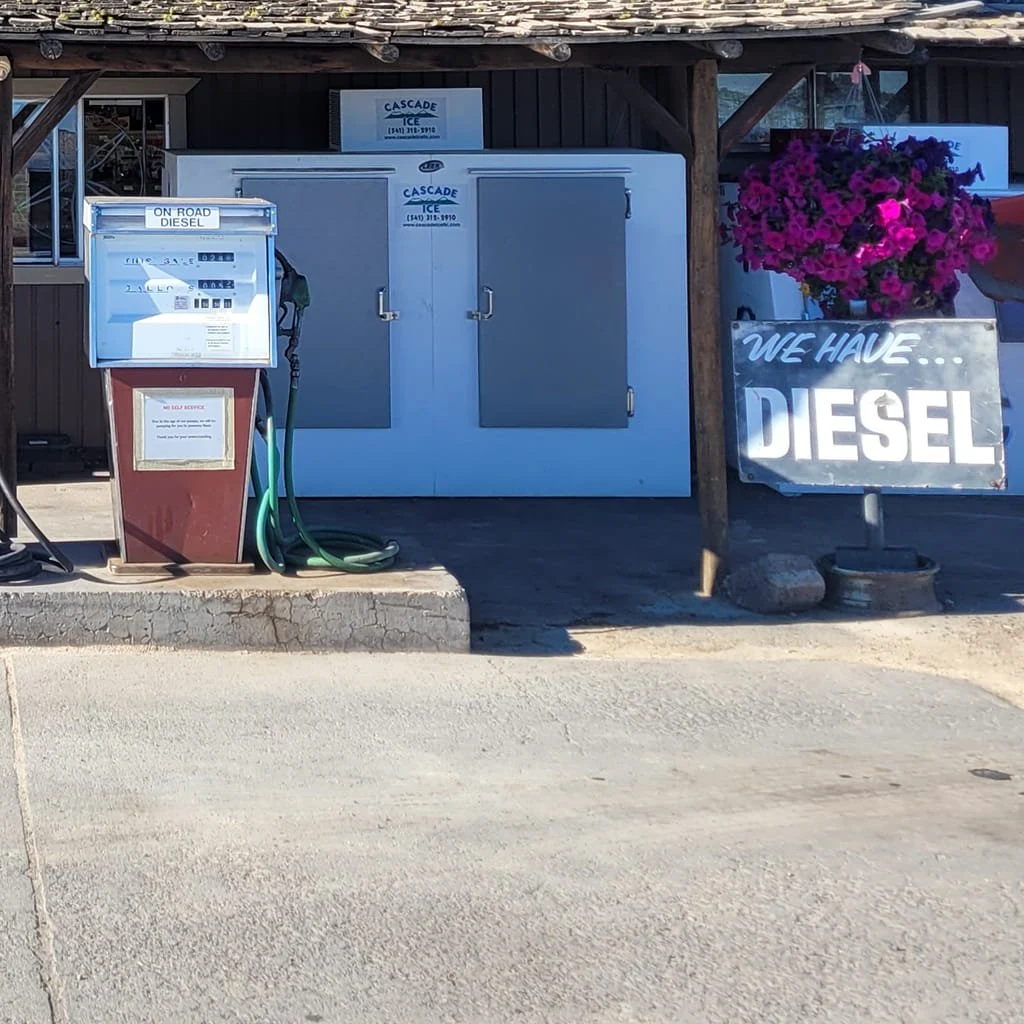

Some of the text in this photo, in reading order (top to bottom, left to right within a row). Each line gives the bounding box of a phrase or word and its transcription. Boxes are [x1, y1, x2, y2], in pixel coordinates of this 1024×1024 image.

[384, 100, 437, 112] CASCADE
[403, 117, 420, 126] ICE
[403, 185, 458, 198] CASCADE
[153, 207, 212, 217] ON ROAD
[422, 204, 440, 214] ICE
[160, 217, 205, 228] DIESEL
[743, 332, 816, 363] WE
[745, 387, 995, 464] DIESEL
